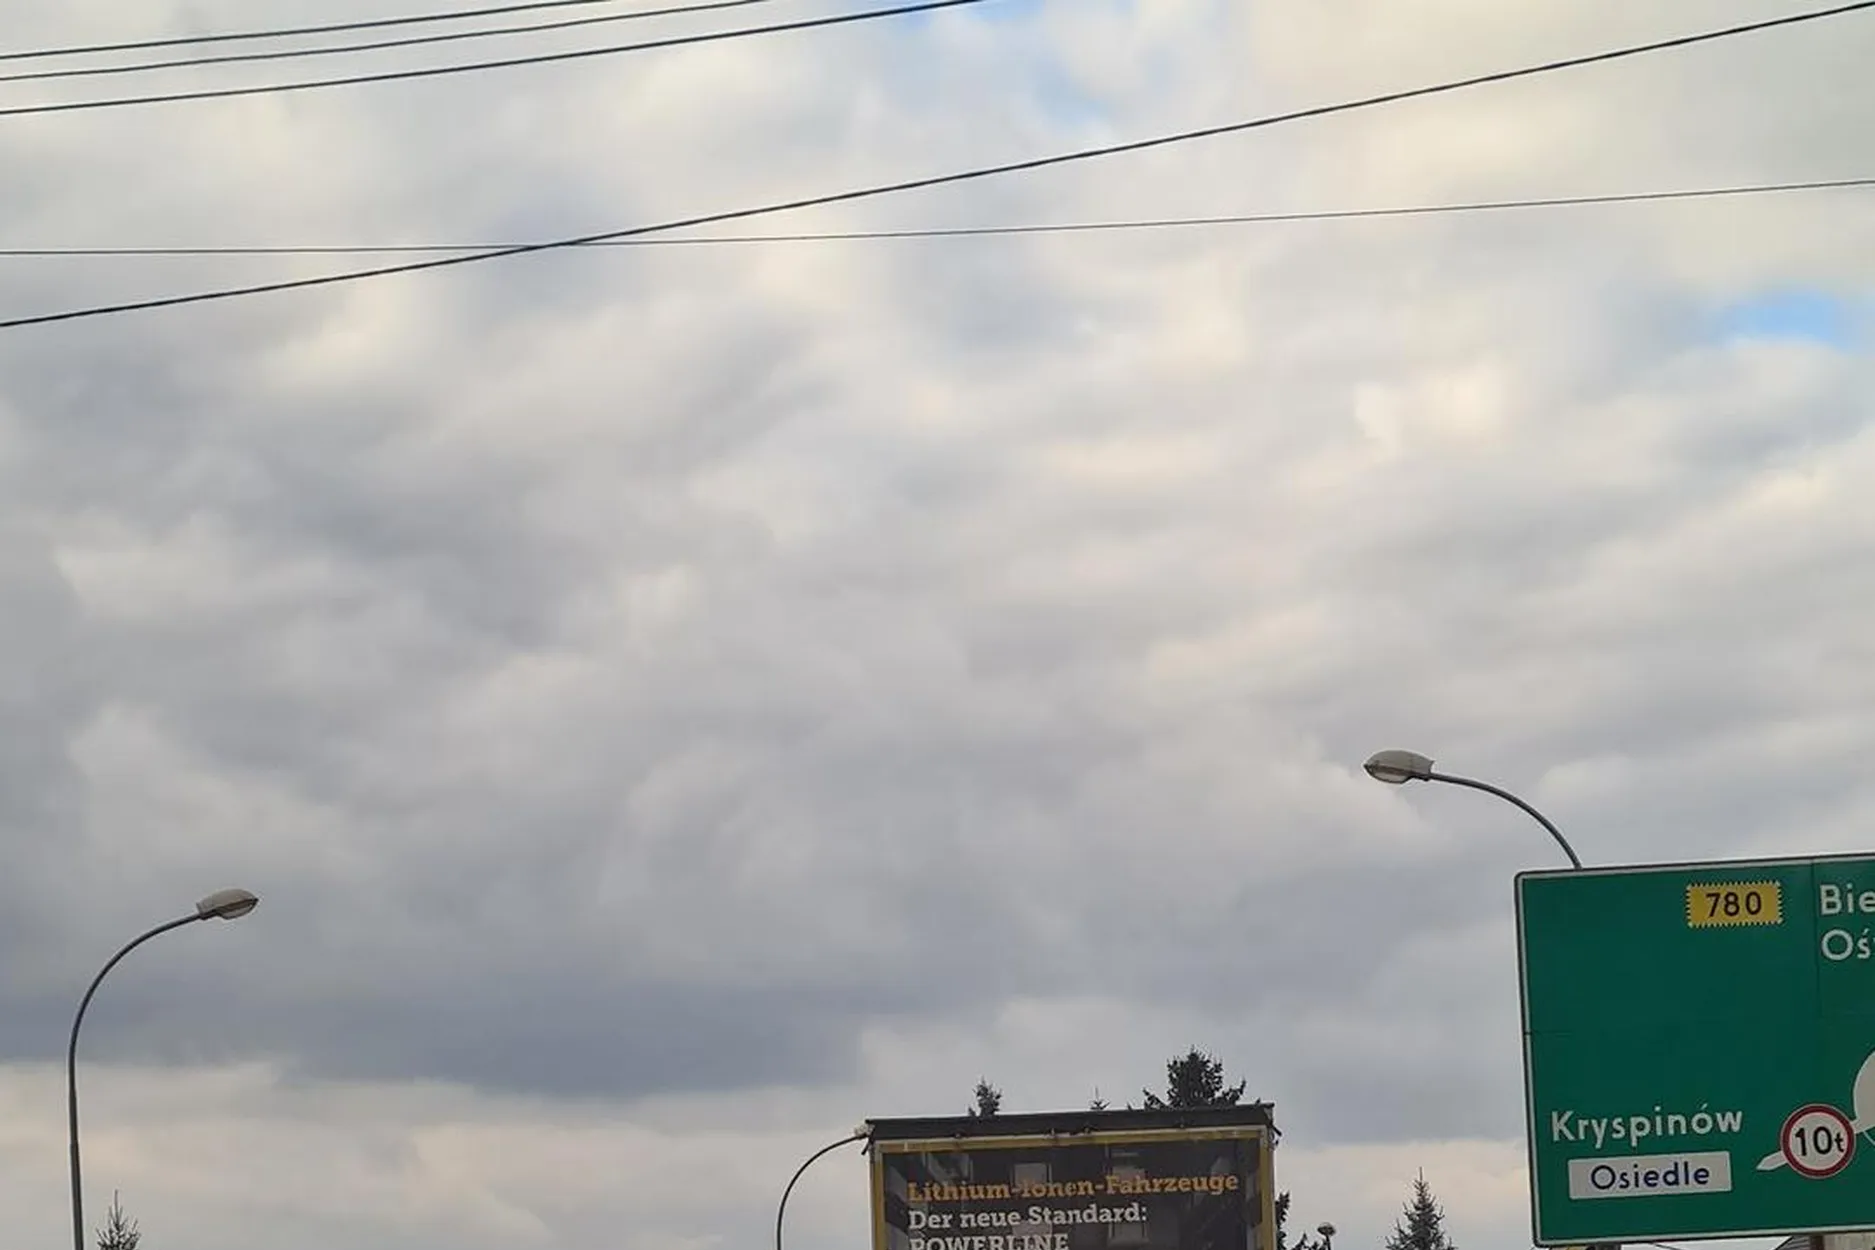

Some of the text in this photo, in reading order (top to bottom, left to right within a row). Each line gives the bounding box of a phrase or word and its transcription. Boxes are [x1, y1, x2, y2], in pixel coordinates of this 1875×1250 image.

[1705, 892, 1763, 918] 780
[1821, 928, 1875, 961] Oś
[1551, 1103, 1743, 1149] Kryspinów
[1794, 1126, 1845, 1158] 10t
[1591, 1162, 1710, 1190] Osiedle
[908, 1202, 1148, 1230] Der neue Standard:
